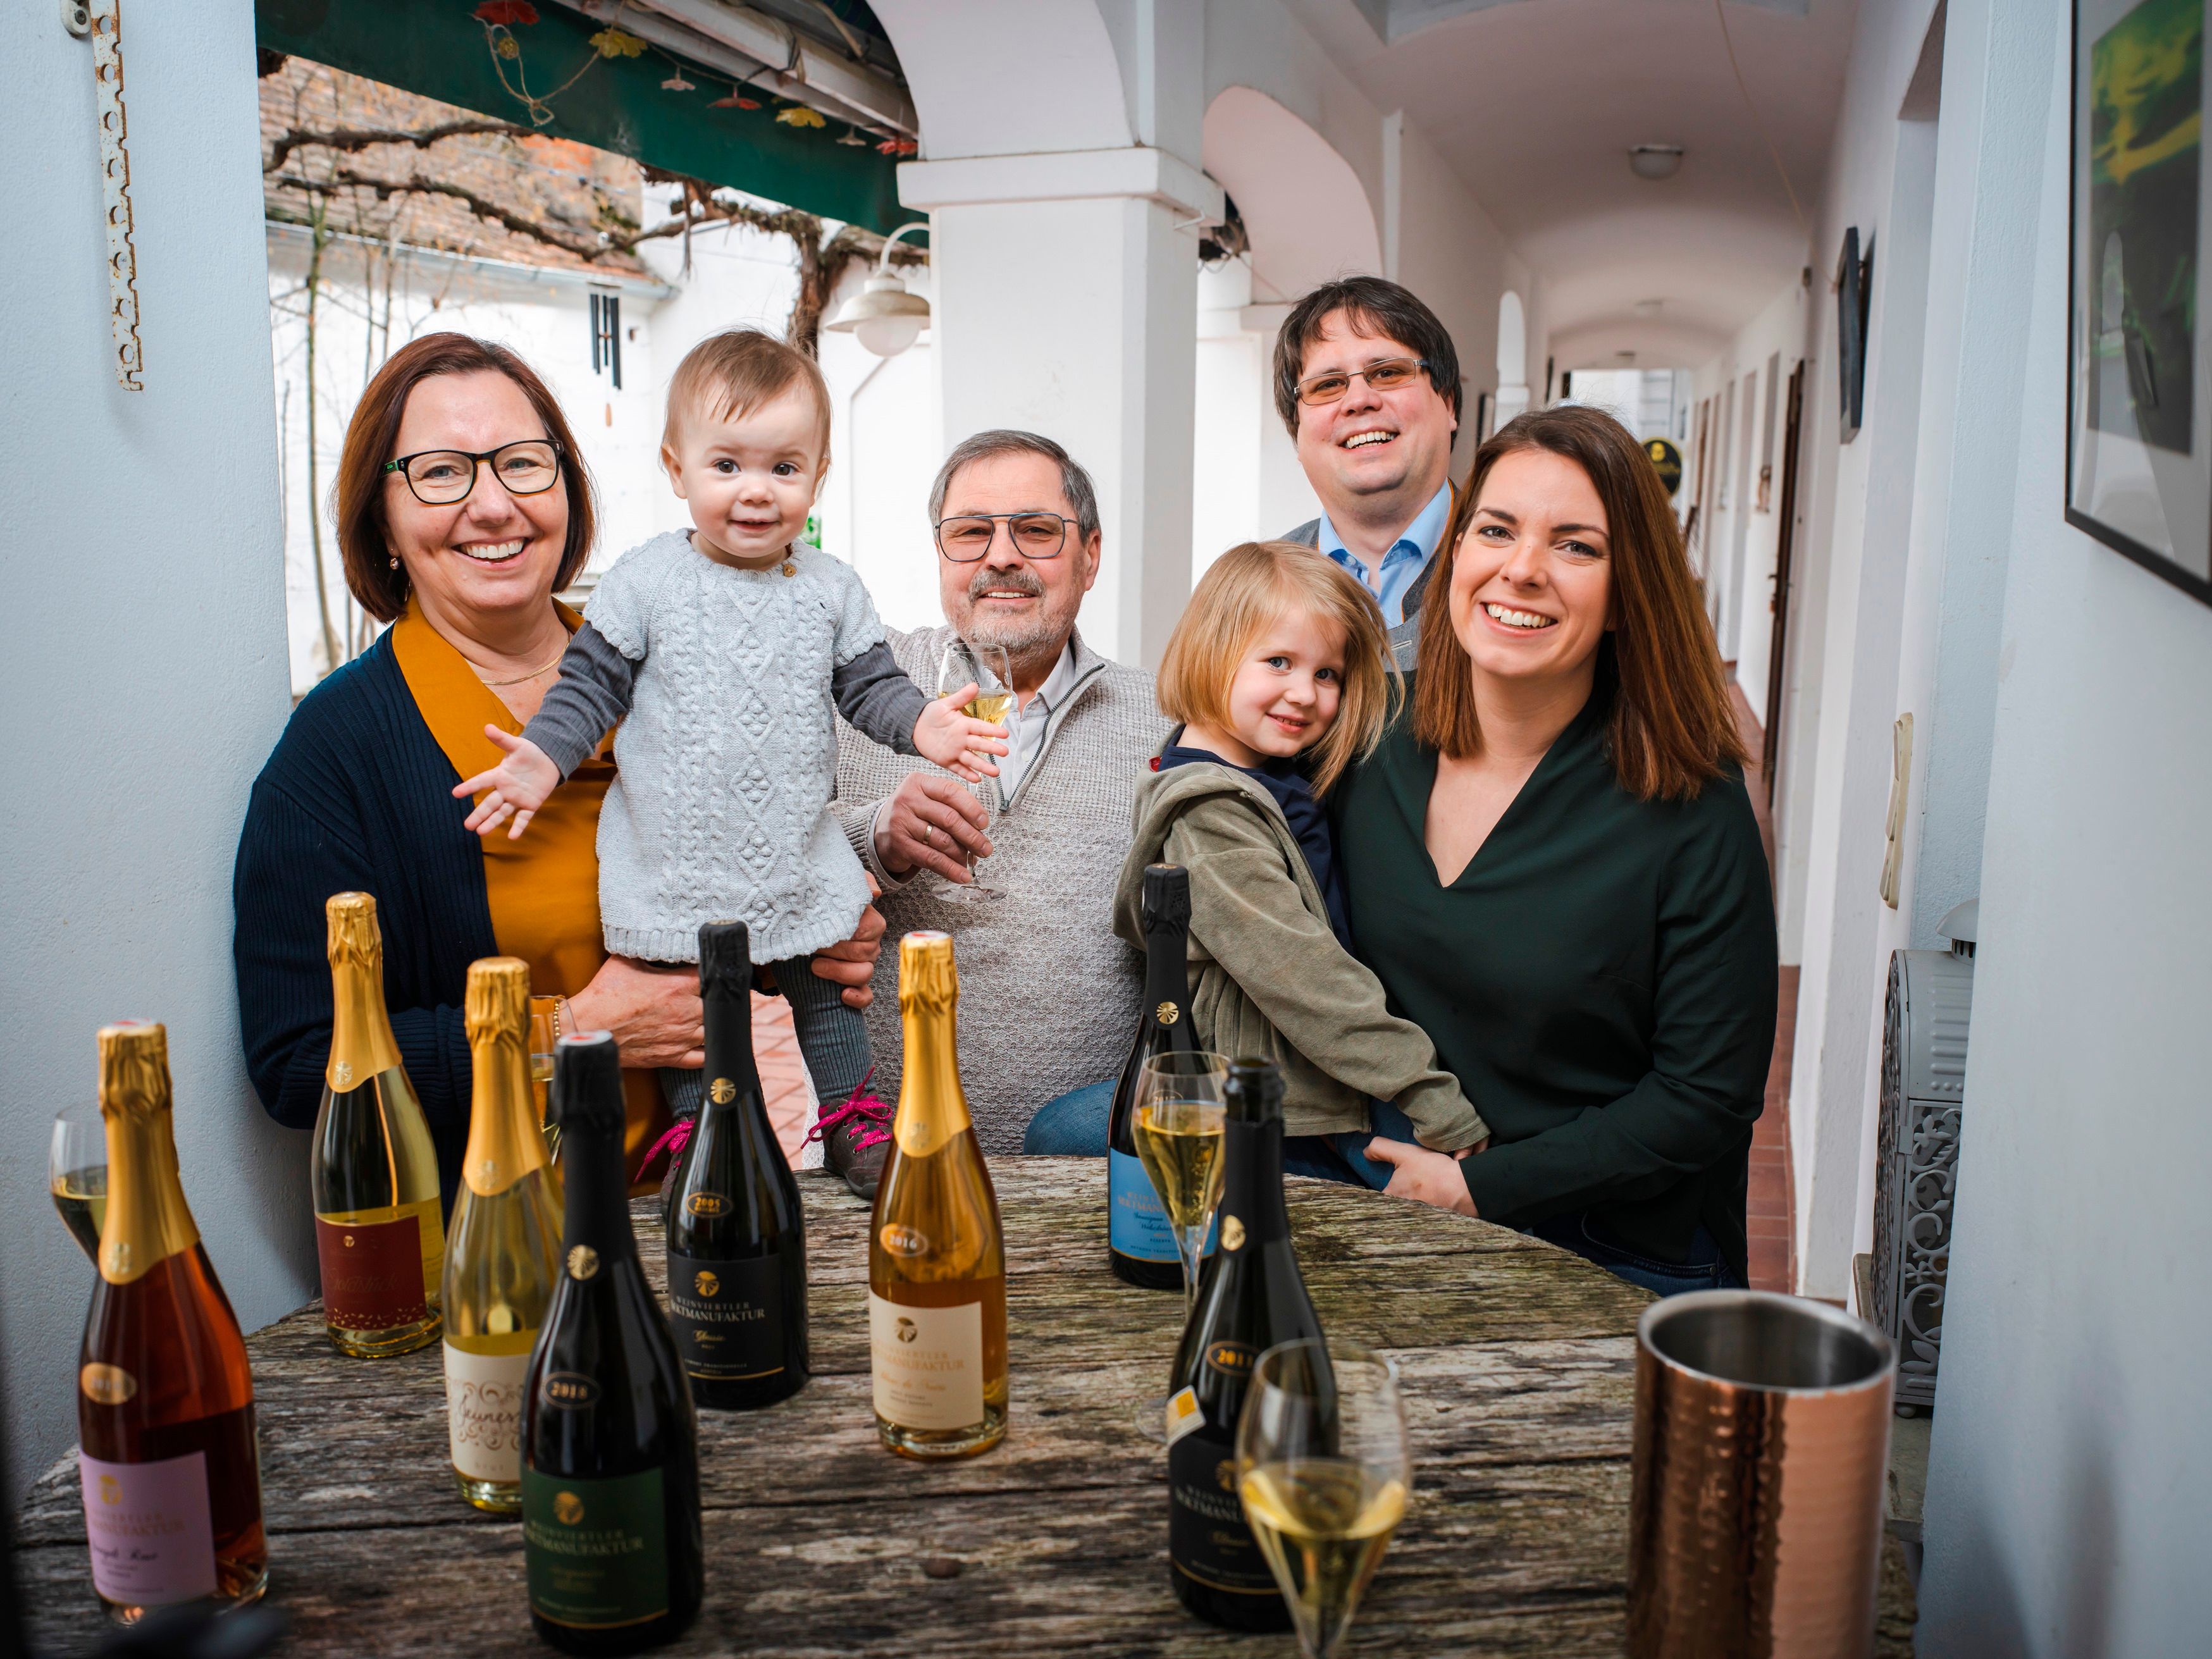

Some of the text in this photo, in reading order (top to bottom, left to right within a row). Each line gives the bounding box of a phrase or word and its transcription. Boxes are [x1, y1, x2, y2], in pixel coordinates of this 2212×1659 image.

[888, 1234, 918, 1250] 2016
[676, 1295, 750, 1311] WEINVIERTLER
[454, 1393, 519, 1428] Jeunes
